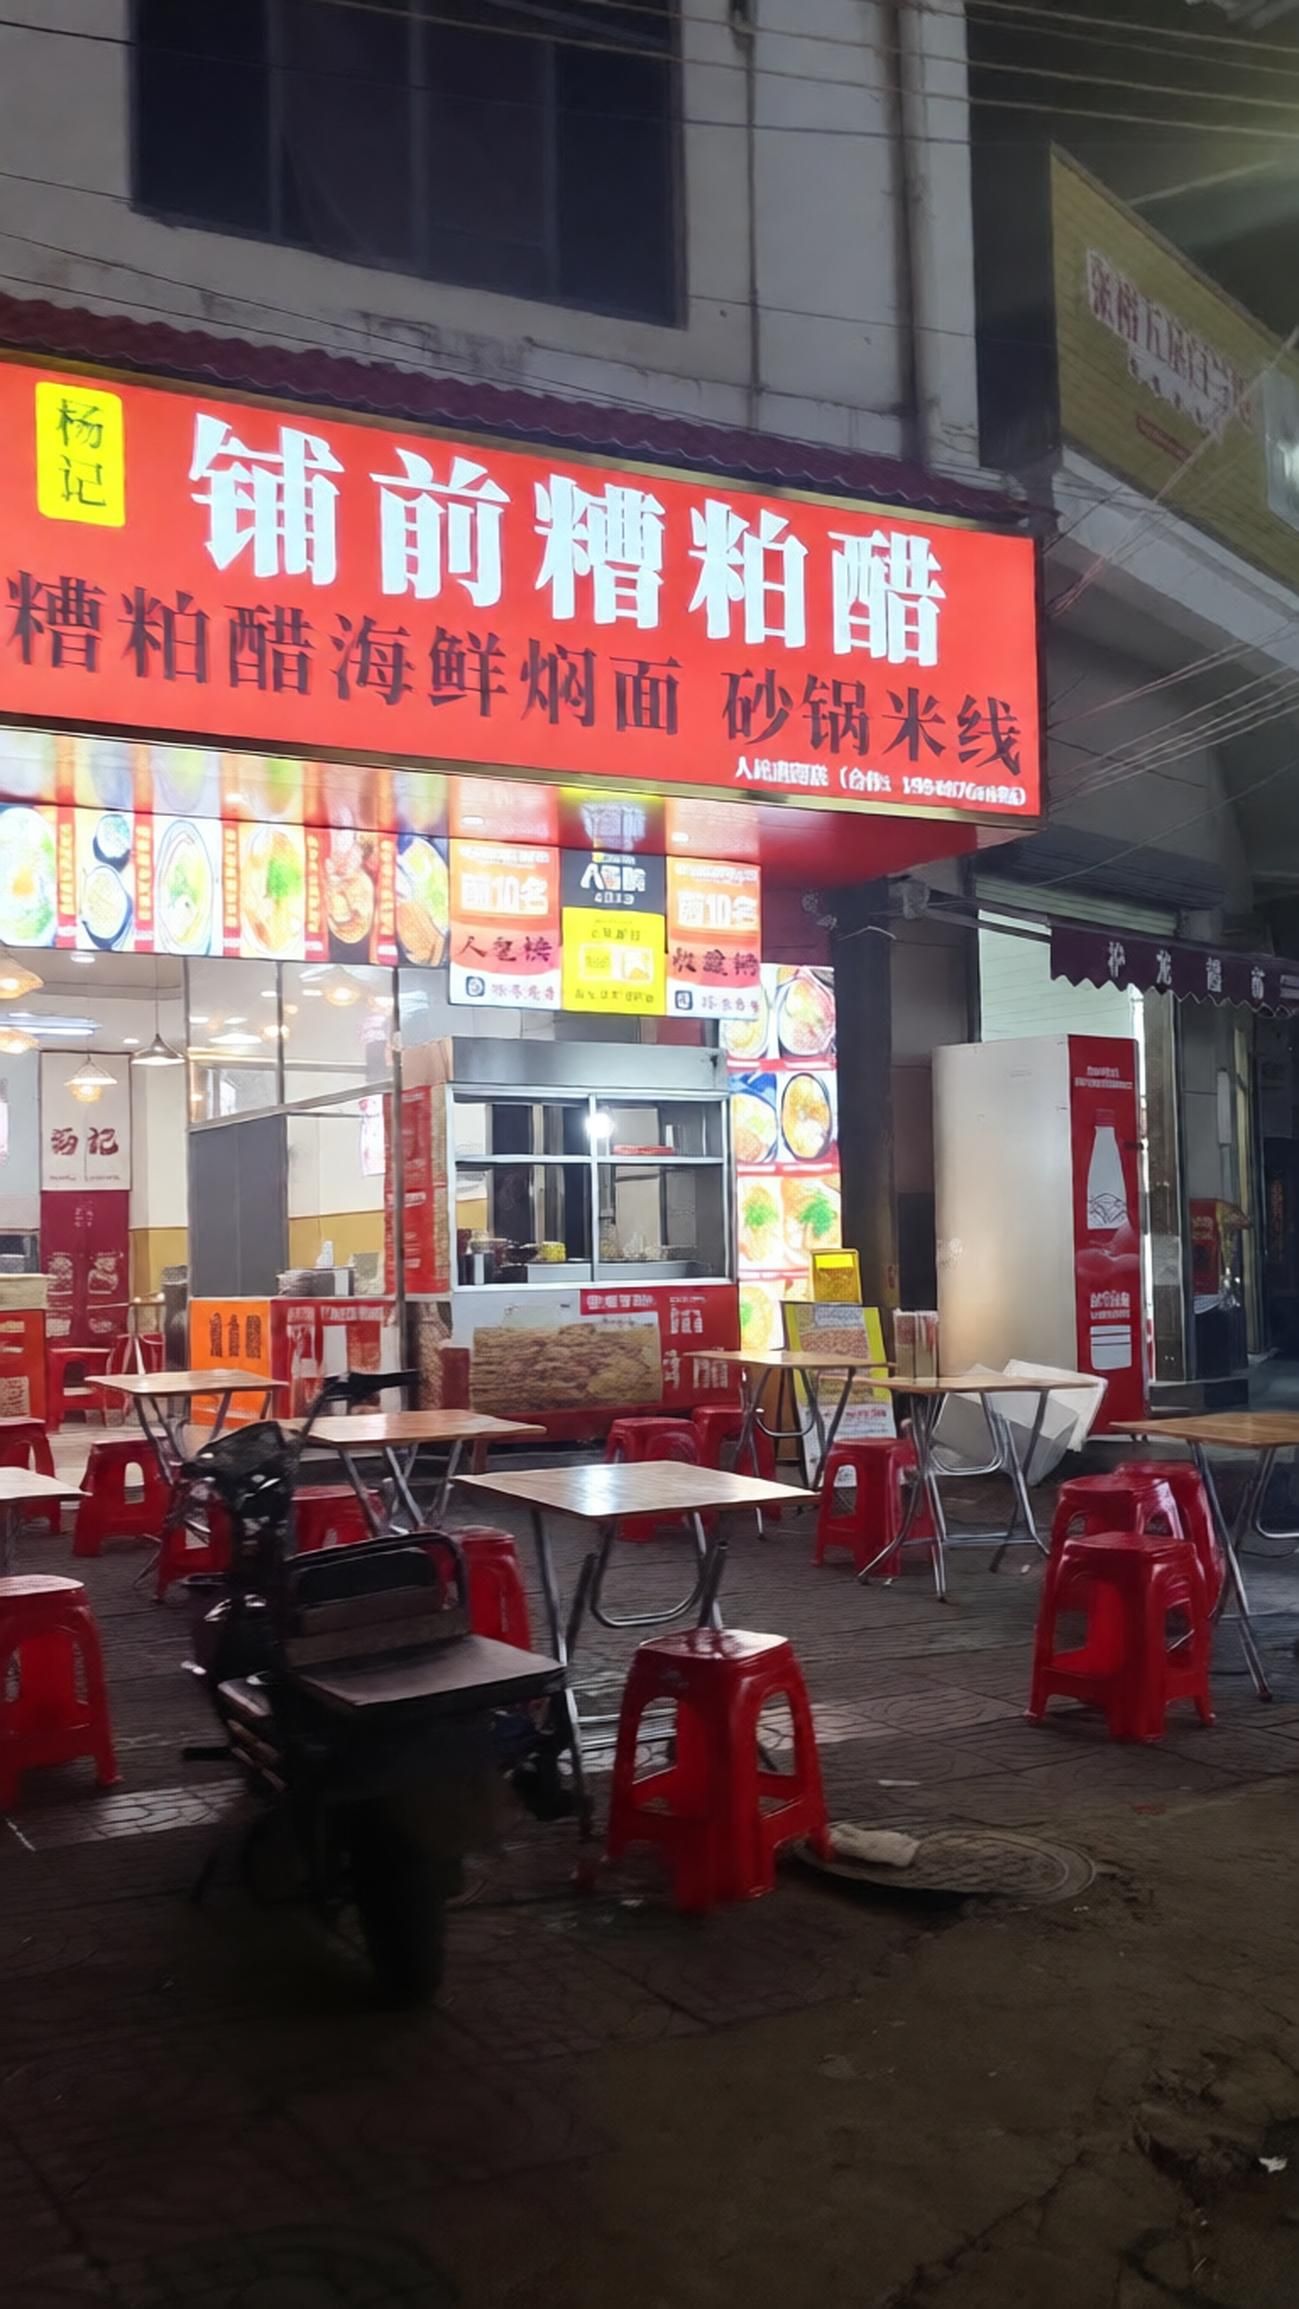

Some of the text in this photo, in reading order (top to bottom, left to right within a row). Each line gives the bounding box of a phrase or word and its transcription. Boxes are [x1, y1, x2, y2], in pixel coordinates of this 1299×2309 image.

[57, 398, 107, 508] 杨记
[188, 412, 946, 667] 铺前糟粕醋
[6, 570, 1021, 776] 糟粕醋海鲜焖面 砂锅米线
